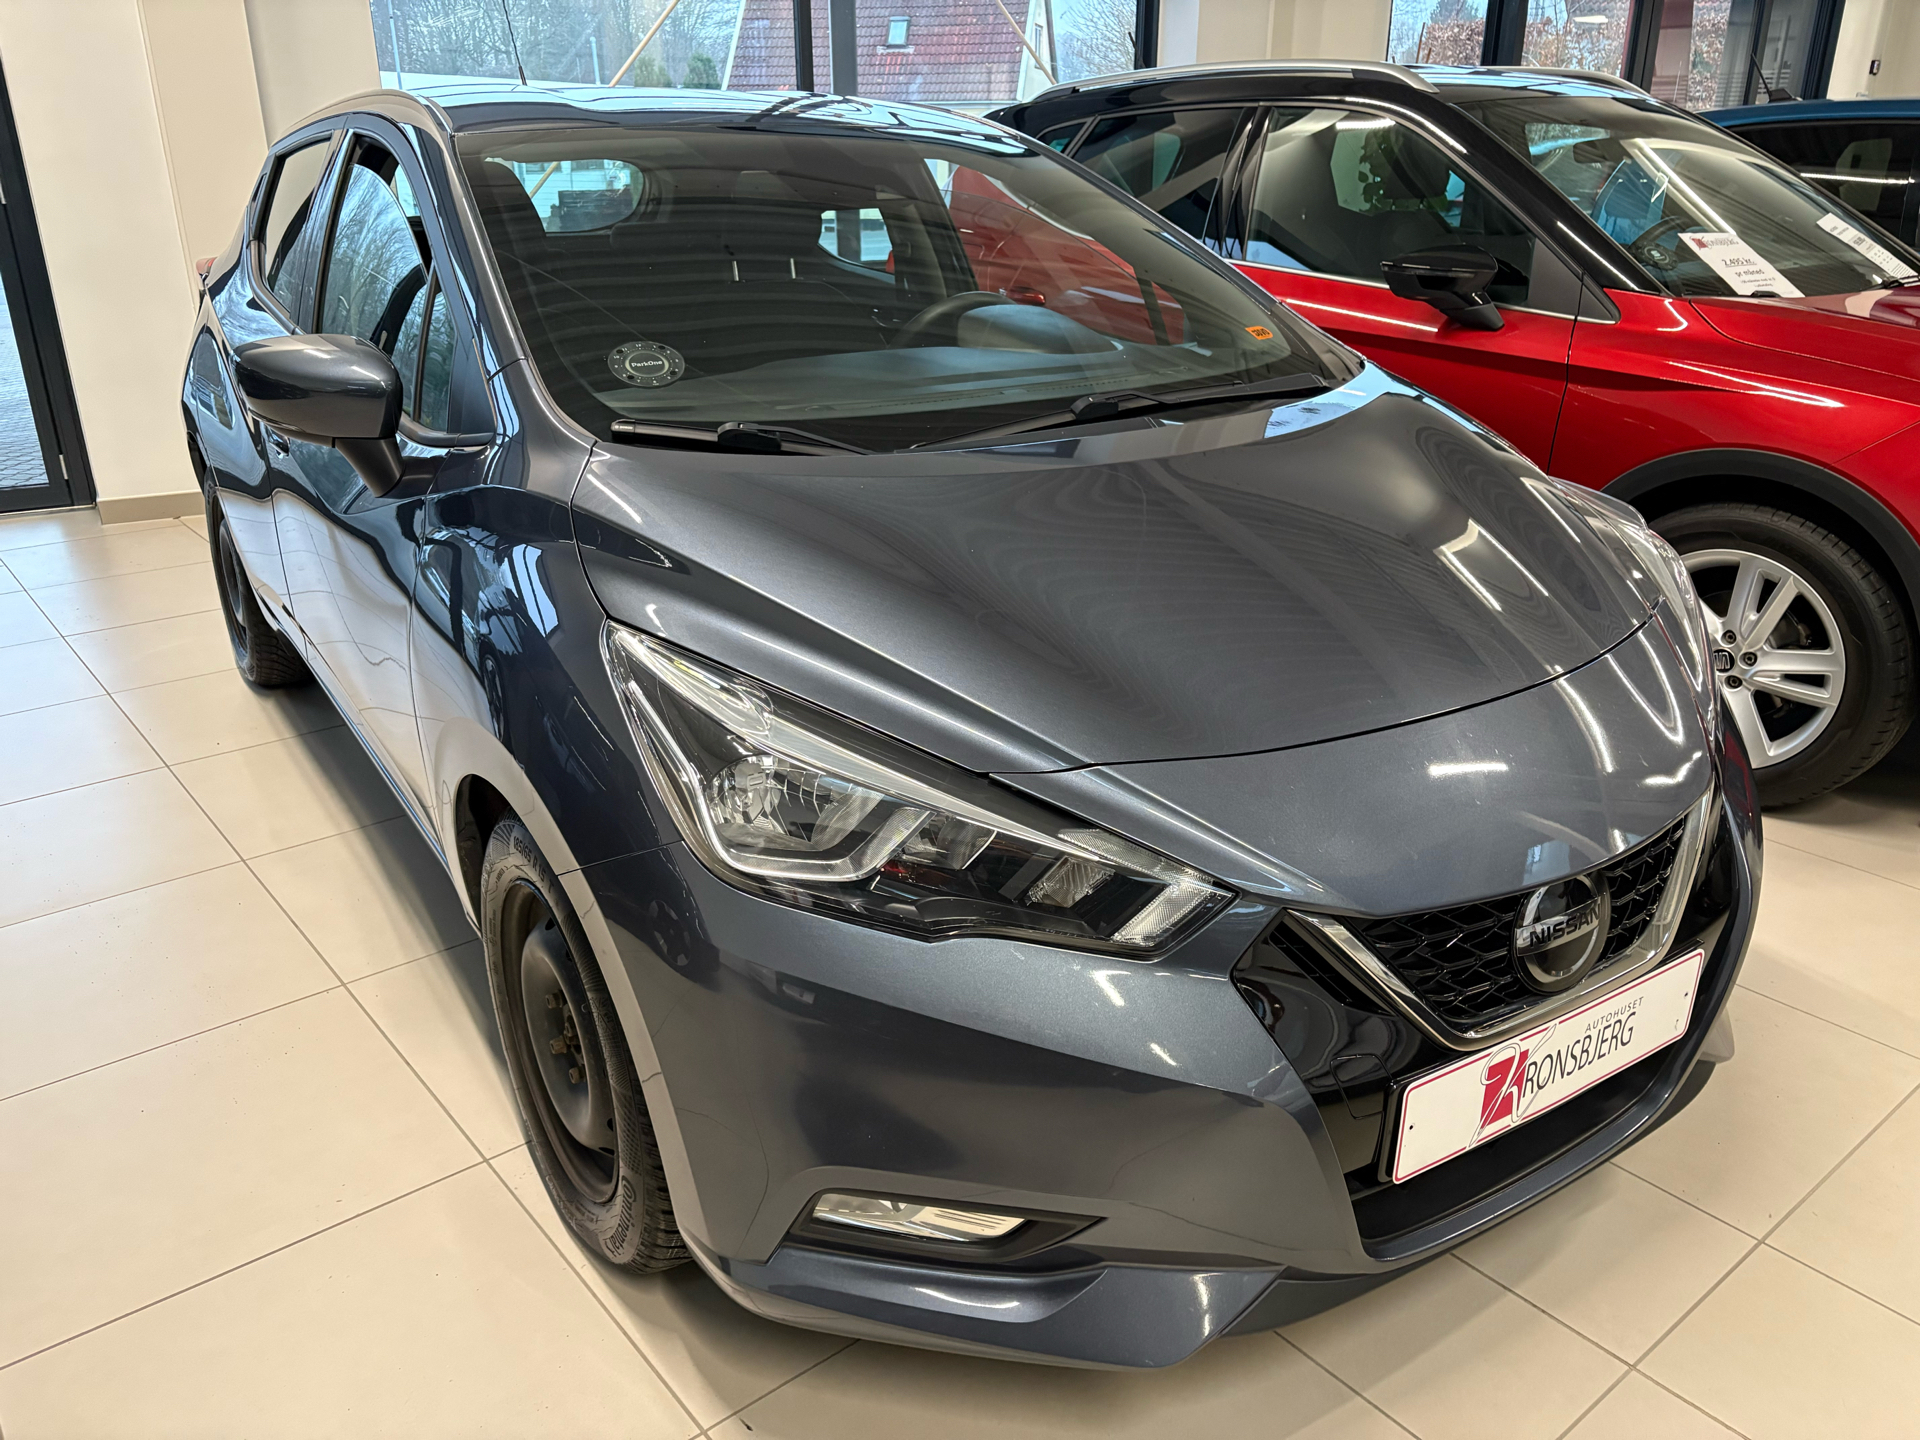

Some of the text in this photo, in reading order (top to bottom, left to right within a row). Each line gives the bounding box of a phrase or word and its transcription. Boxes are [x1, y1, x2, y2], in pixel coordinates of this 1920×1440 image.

[631, 360, 663, 368] ParkOne
[1529, 902, 1601, 948] NISSAN
[1584, 996, 1644, 1033] AUTOHUSET
[602, 1175, 637, 1257] Continental
